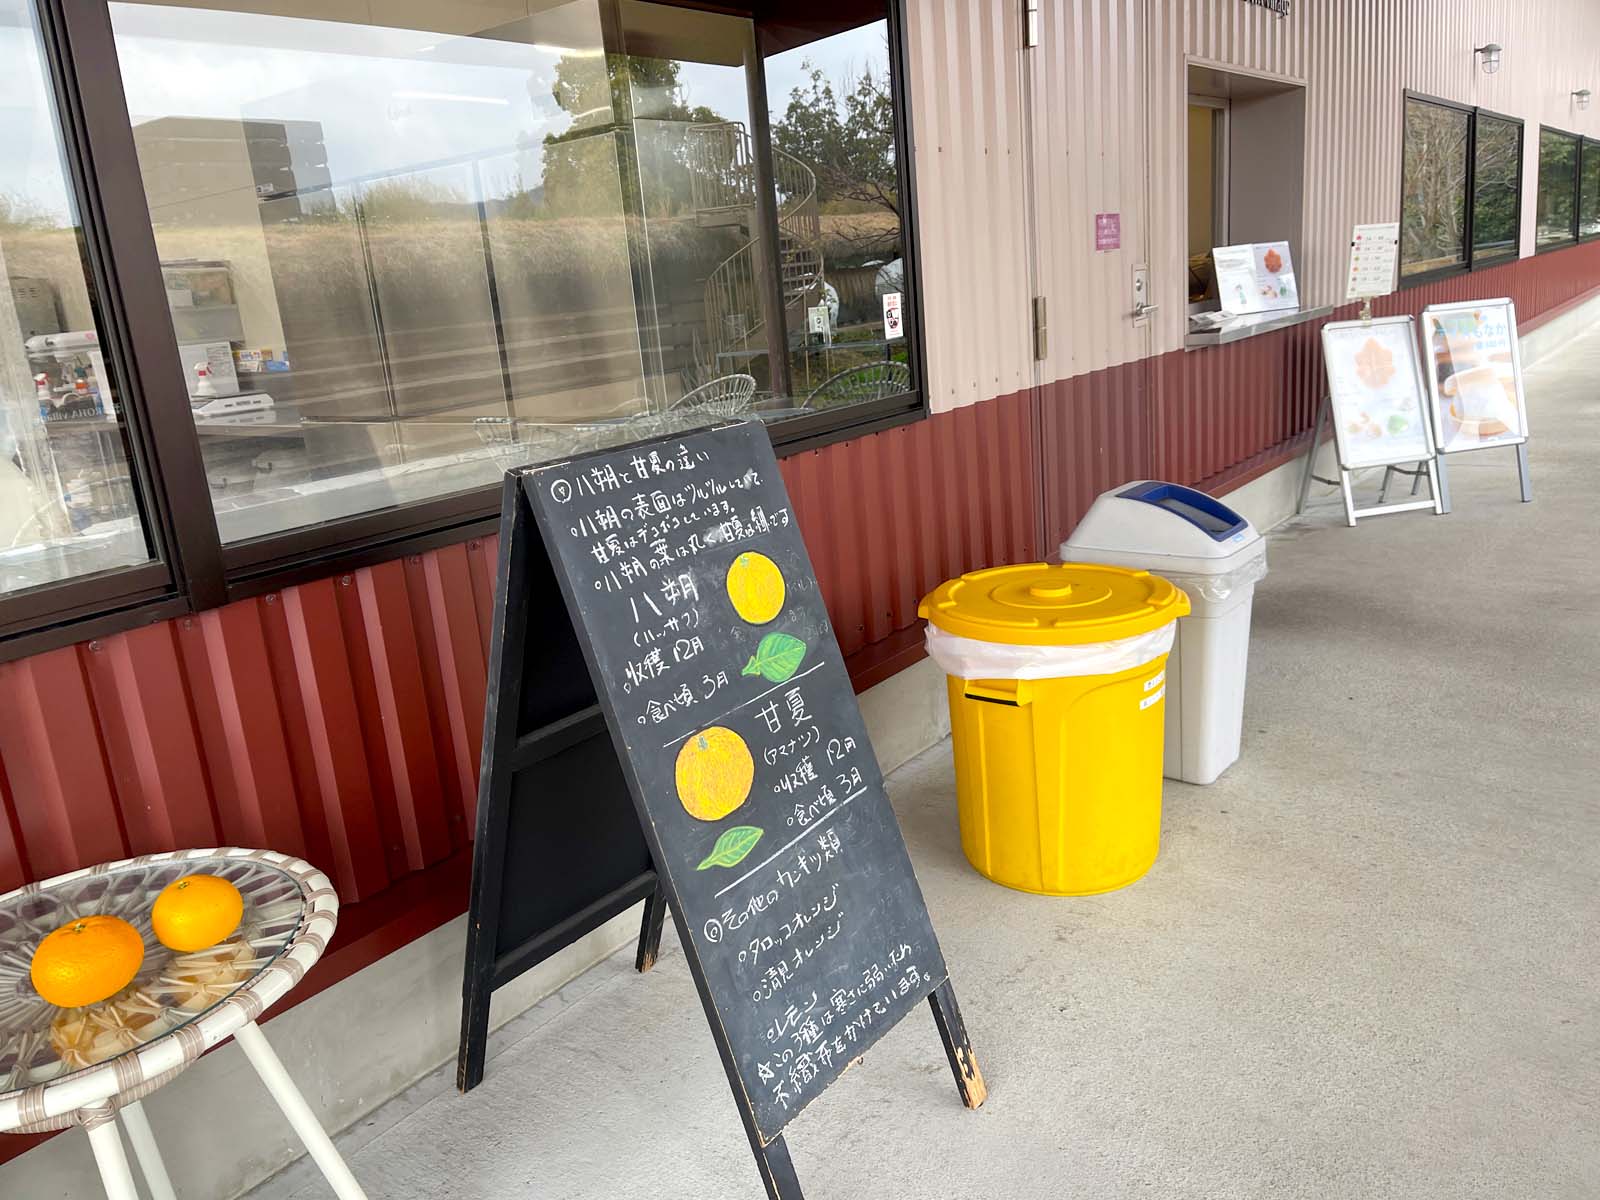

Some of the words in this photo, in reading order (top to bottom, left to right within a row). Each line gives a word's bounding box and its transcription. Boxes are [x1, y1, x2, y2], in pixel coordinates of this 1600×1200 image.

[630, 573, 699, 623] 八朔
[673, 636, 704, 663] 12月
[702, 671, 729, 699] 3月
[754, 686, 813, 733] 甘夏
[826, 736, 857, 766] 12月
[836, 767, 863, 794] 3月
[773, 991, 818, 1044] レモン
